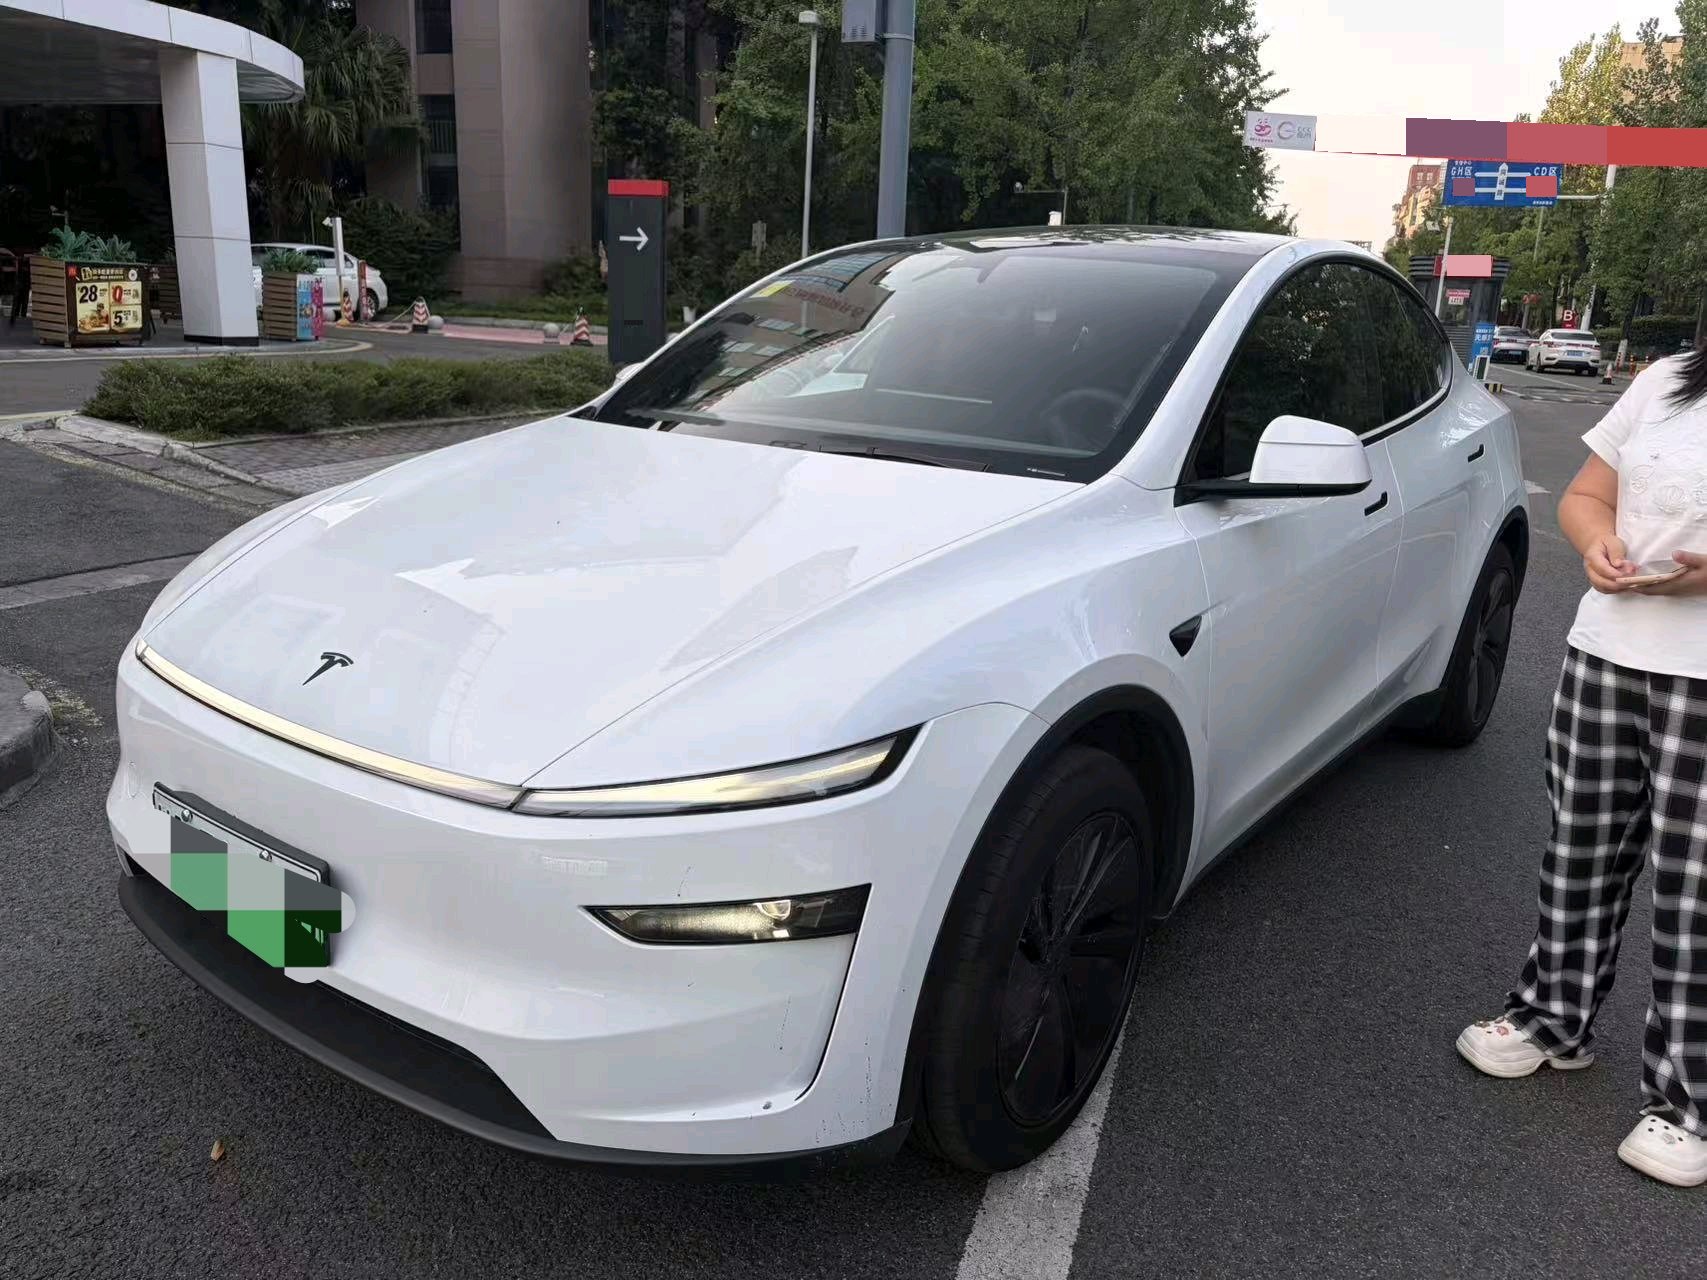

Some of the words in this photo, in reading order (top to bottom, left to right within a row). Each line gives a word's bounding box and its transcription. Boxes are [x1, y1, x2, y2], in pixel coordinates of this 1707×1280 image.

[1451, 166, 1473, 176] GH区
[1534, 166, 1558, 177] CD区
[1563, 309, 1573, 321] B
